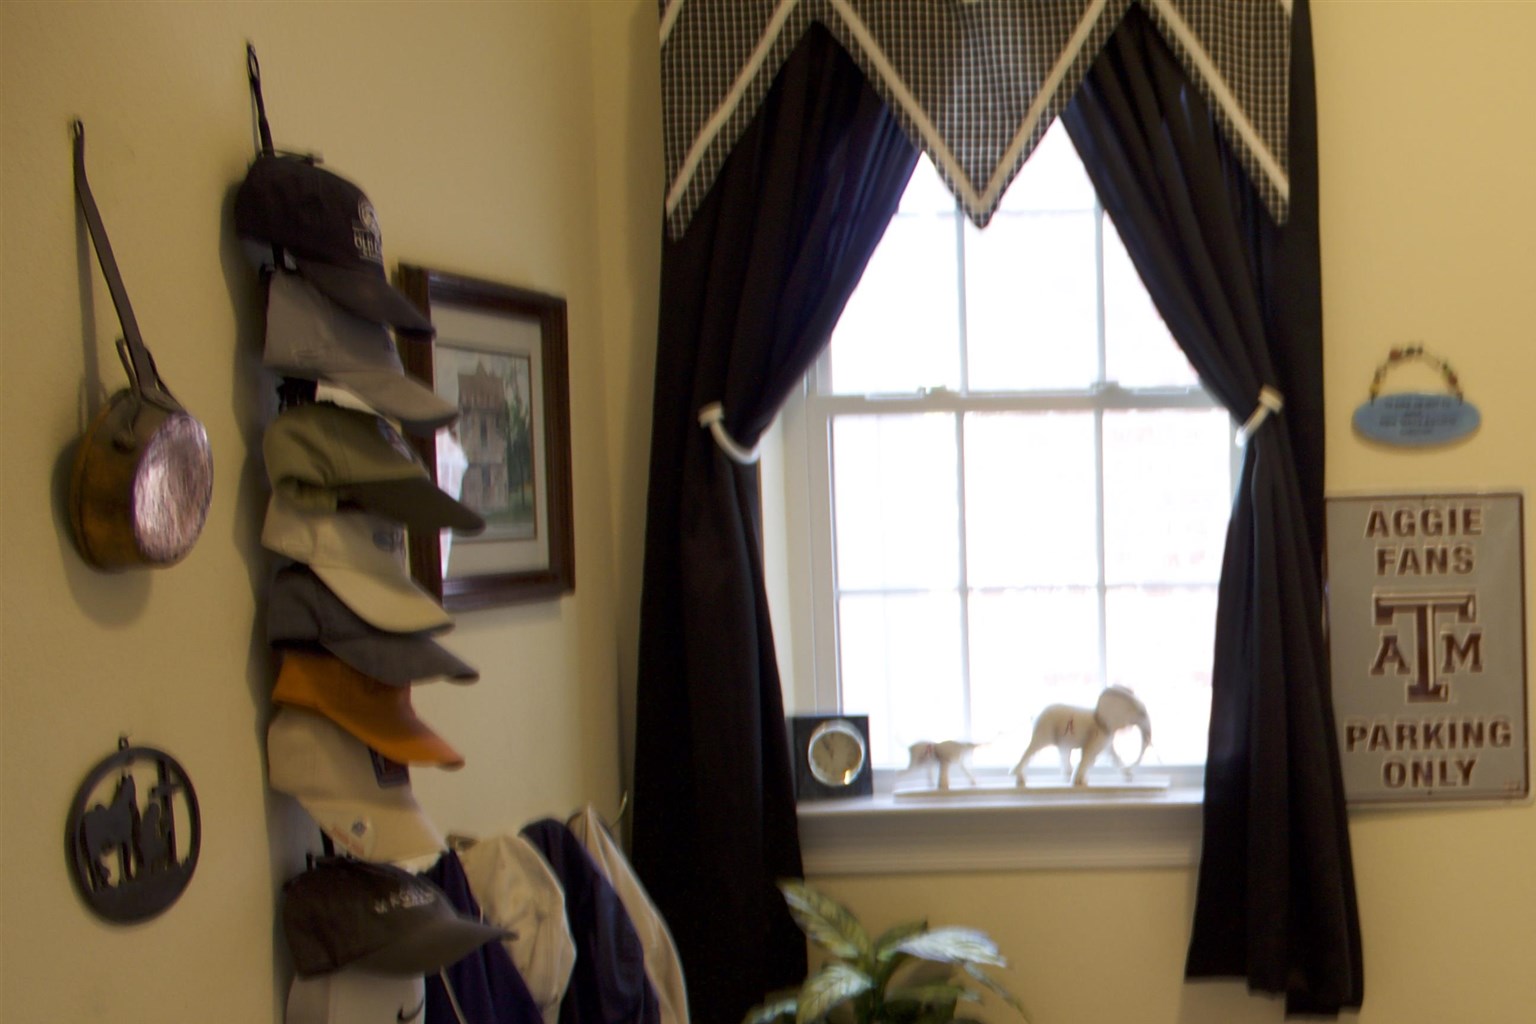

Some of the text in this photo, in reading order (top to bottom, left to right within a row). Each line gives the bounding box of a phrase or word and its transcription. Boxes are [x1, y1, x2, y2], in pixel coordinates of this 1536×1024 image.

[1365, 507, 1482, 538] AGGIE
[1376, 545, 1474, 576] FANS
[1345, 720, 1512, 753] PARKING
[1383, 758, 1477, 788] ONLY
